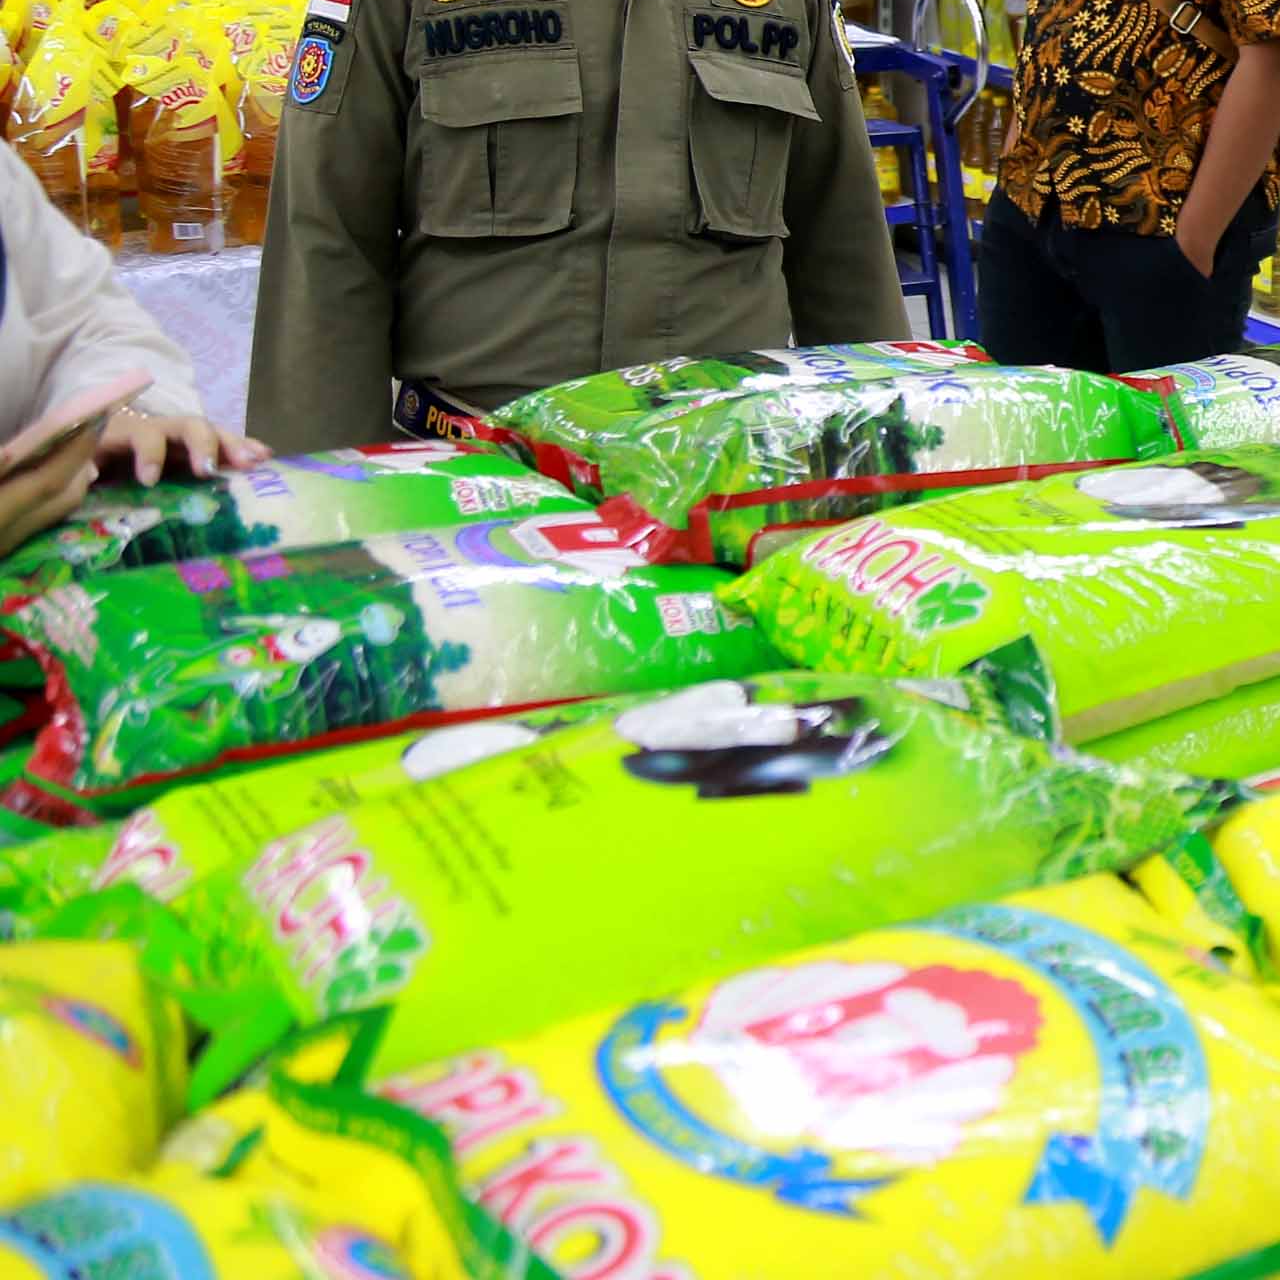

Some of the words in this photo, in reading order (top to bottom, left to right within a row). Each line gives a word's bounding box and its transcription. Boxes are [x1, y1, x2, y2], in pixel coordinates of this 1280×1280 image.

[424, 9, 563, 58] NUGROHO
[694, 14, 758, 54] POL
[761, 23, 799, 59] PP
[803, 518, 960, 619] HOKI
